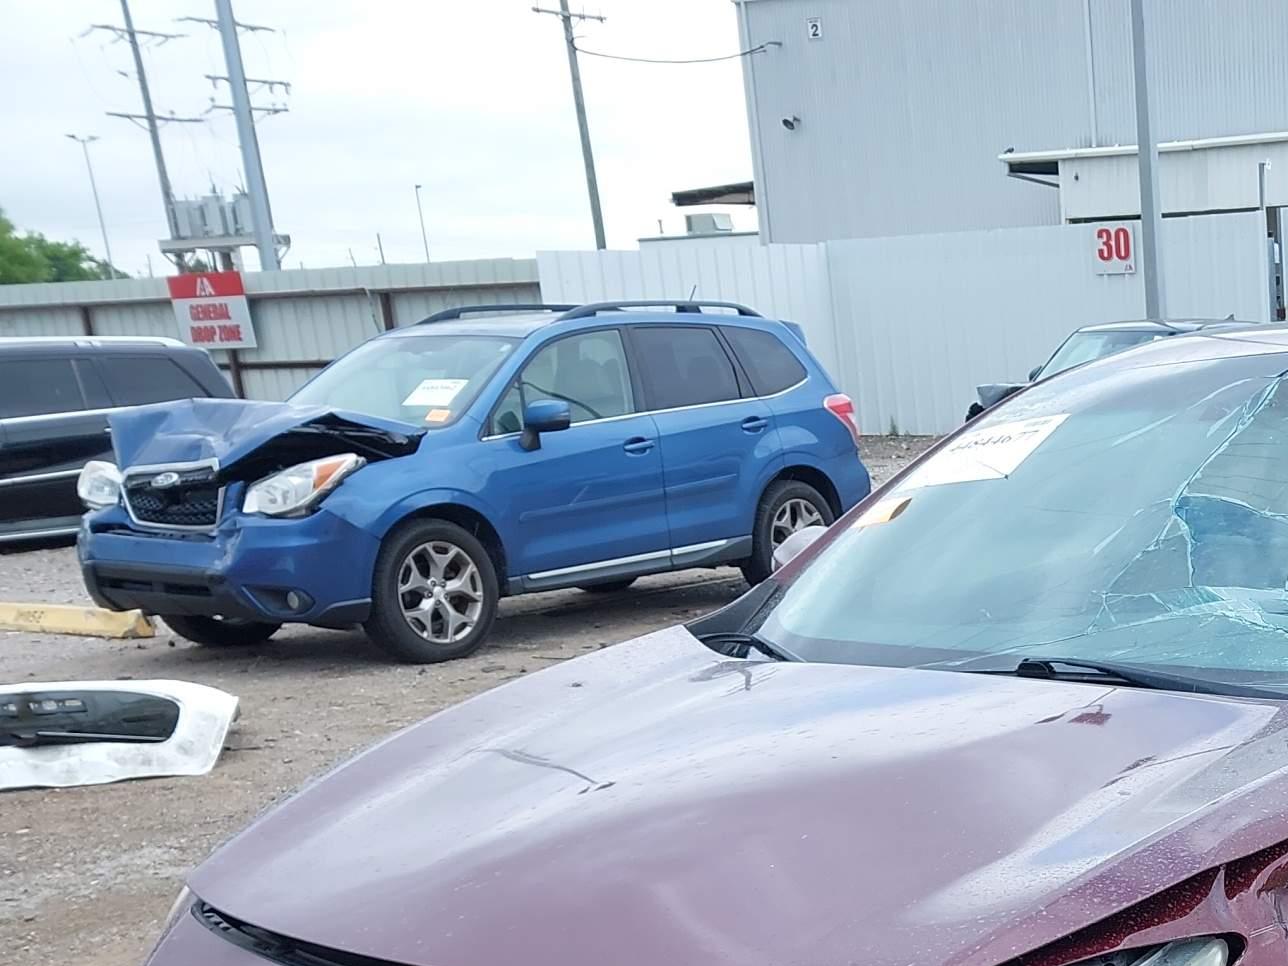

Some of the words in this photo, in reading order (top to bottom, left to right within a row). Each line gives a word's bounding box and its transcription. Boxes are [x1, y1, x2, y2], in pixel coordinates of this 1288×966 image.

[811, 23, 820, 37] 2
[1097, 227, 1130, 261] 30
[189, 302, 232, 321] GENERAL
[190, 325, 217, 343] DROP
[217, 323, 243, 342] ZONE
